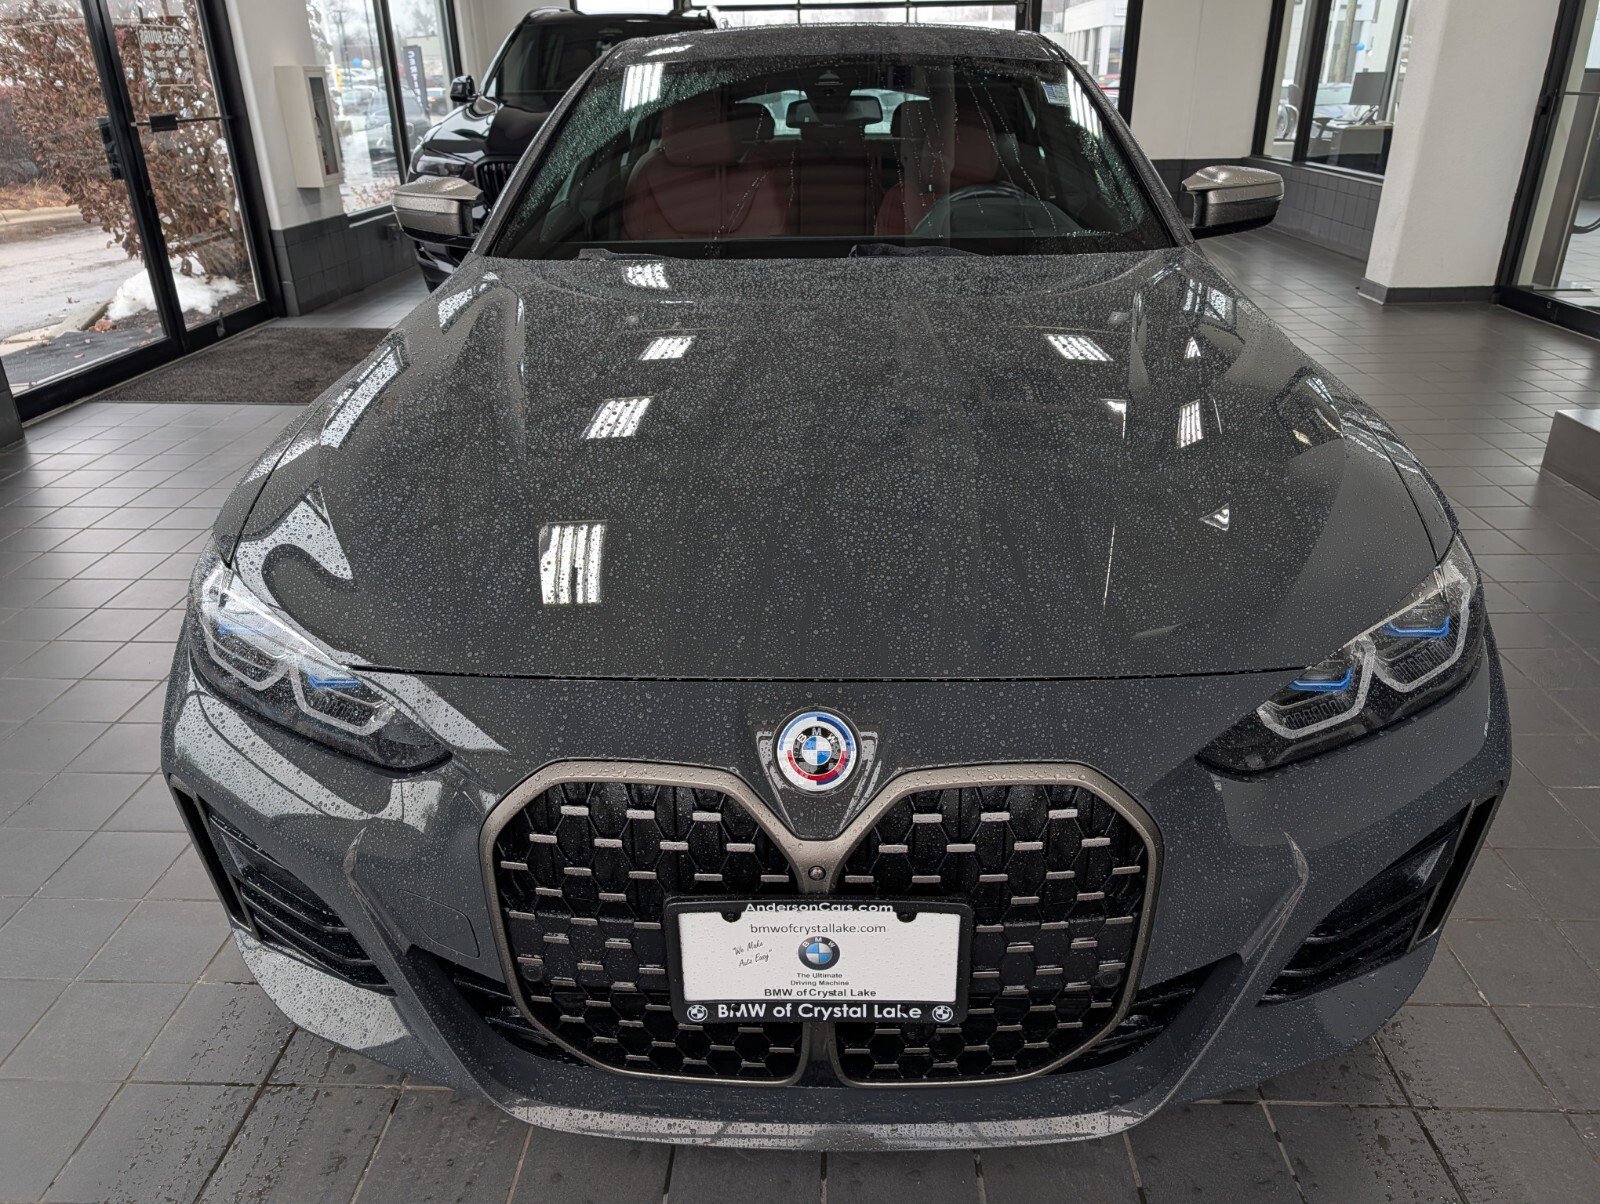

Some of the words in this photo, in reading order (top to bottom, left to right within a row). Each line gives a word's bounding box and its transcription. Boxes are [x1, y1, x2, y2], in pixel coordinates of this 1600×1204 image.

[796, 727, 838, 743] BMW
[744, 902, 894, 913] AndersonCars.com
[750, 923, 886, 935] bmwofcrystallake.com
[802, 937, 836, 949] BMW
[764, 988, 793, 998] BMW
[796, 988, 808, 998] of
[809, 988, 847, 999] Crystal
[850, 988, 877, 998] Lake
[717, 1003, 767, 1018] BMW
[772, 1003, 793, 1018] of
[797, 1003, 867, 1021] Crystal
[873, 1004, 923, 1019] Lake
